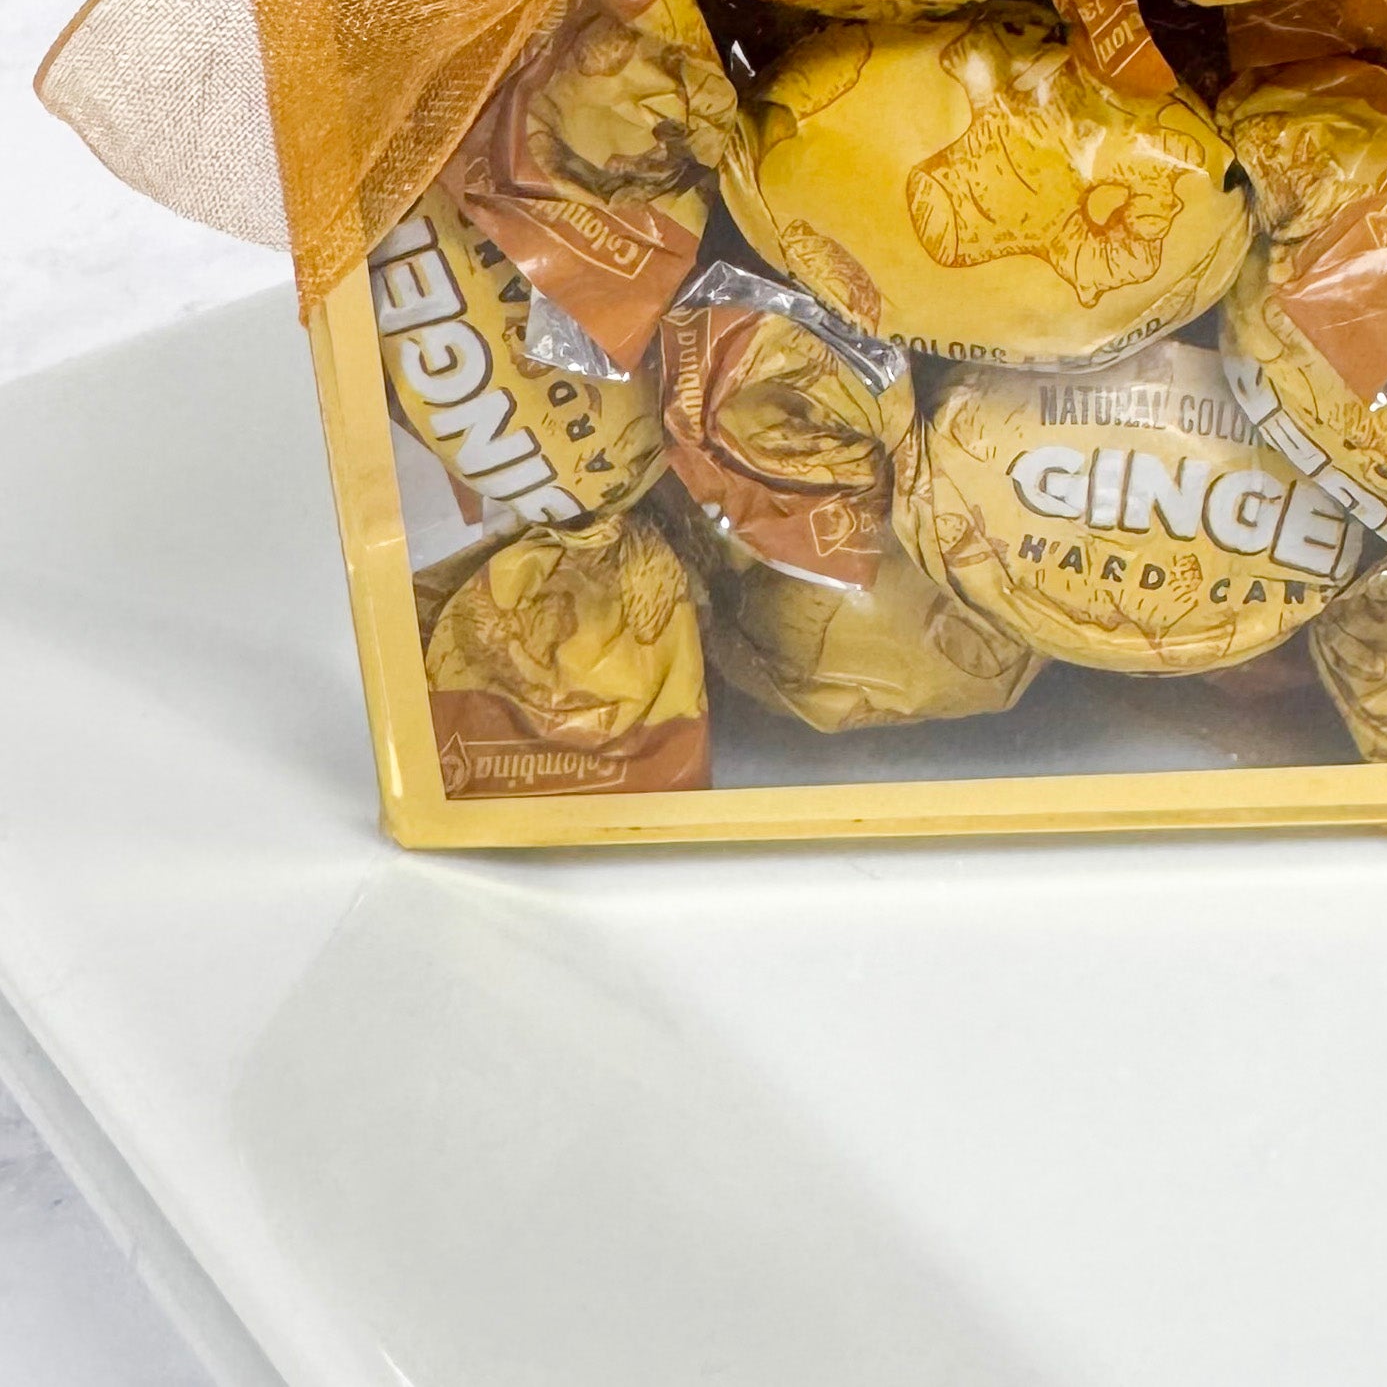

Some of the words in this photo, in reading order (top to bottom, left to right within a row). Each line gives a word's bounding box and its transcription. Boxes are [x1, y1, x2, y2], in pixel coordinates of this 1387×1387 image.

[1005, 446, 1356, 584] GINGE
[1019, 533, 1168, 591] HARD
[1208, 576, 1334, 608] CAN
